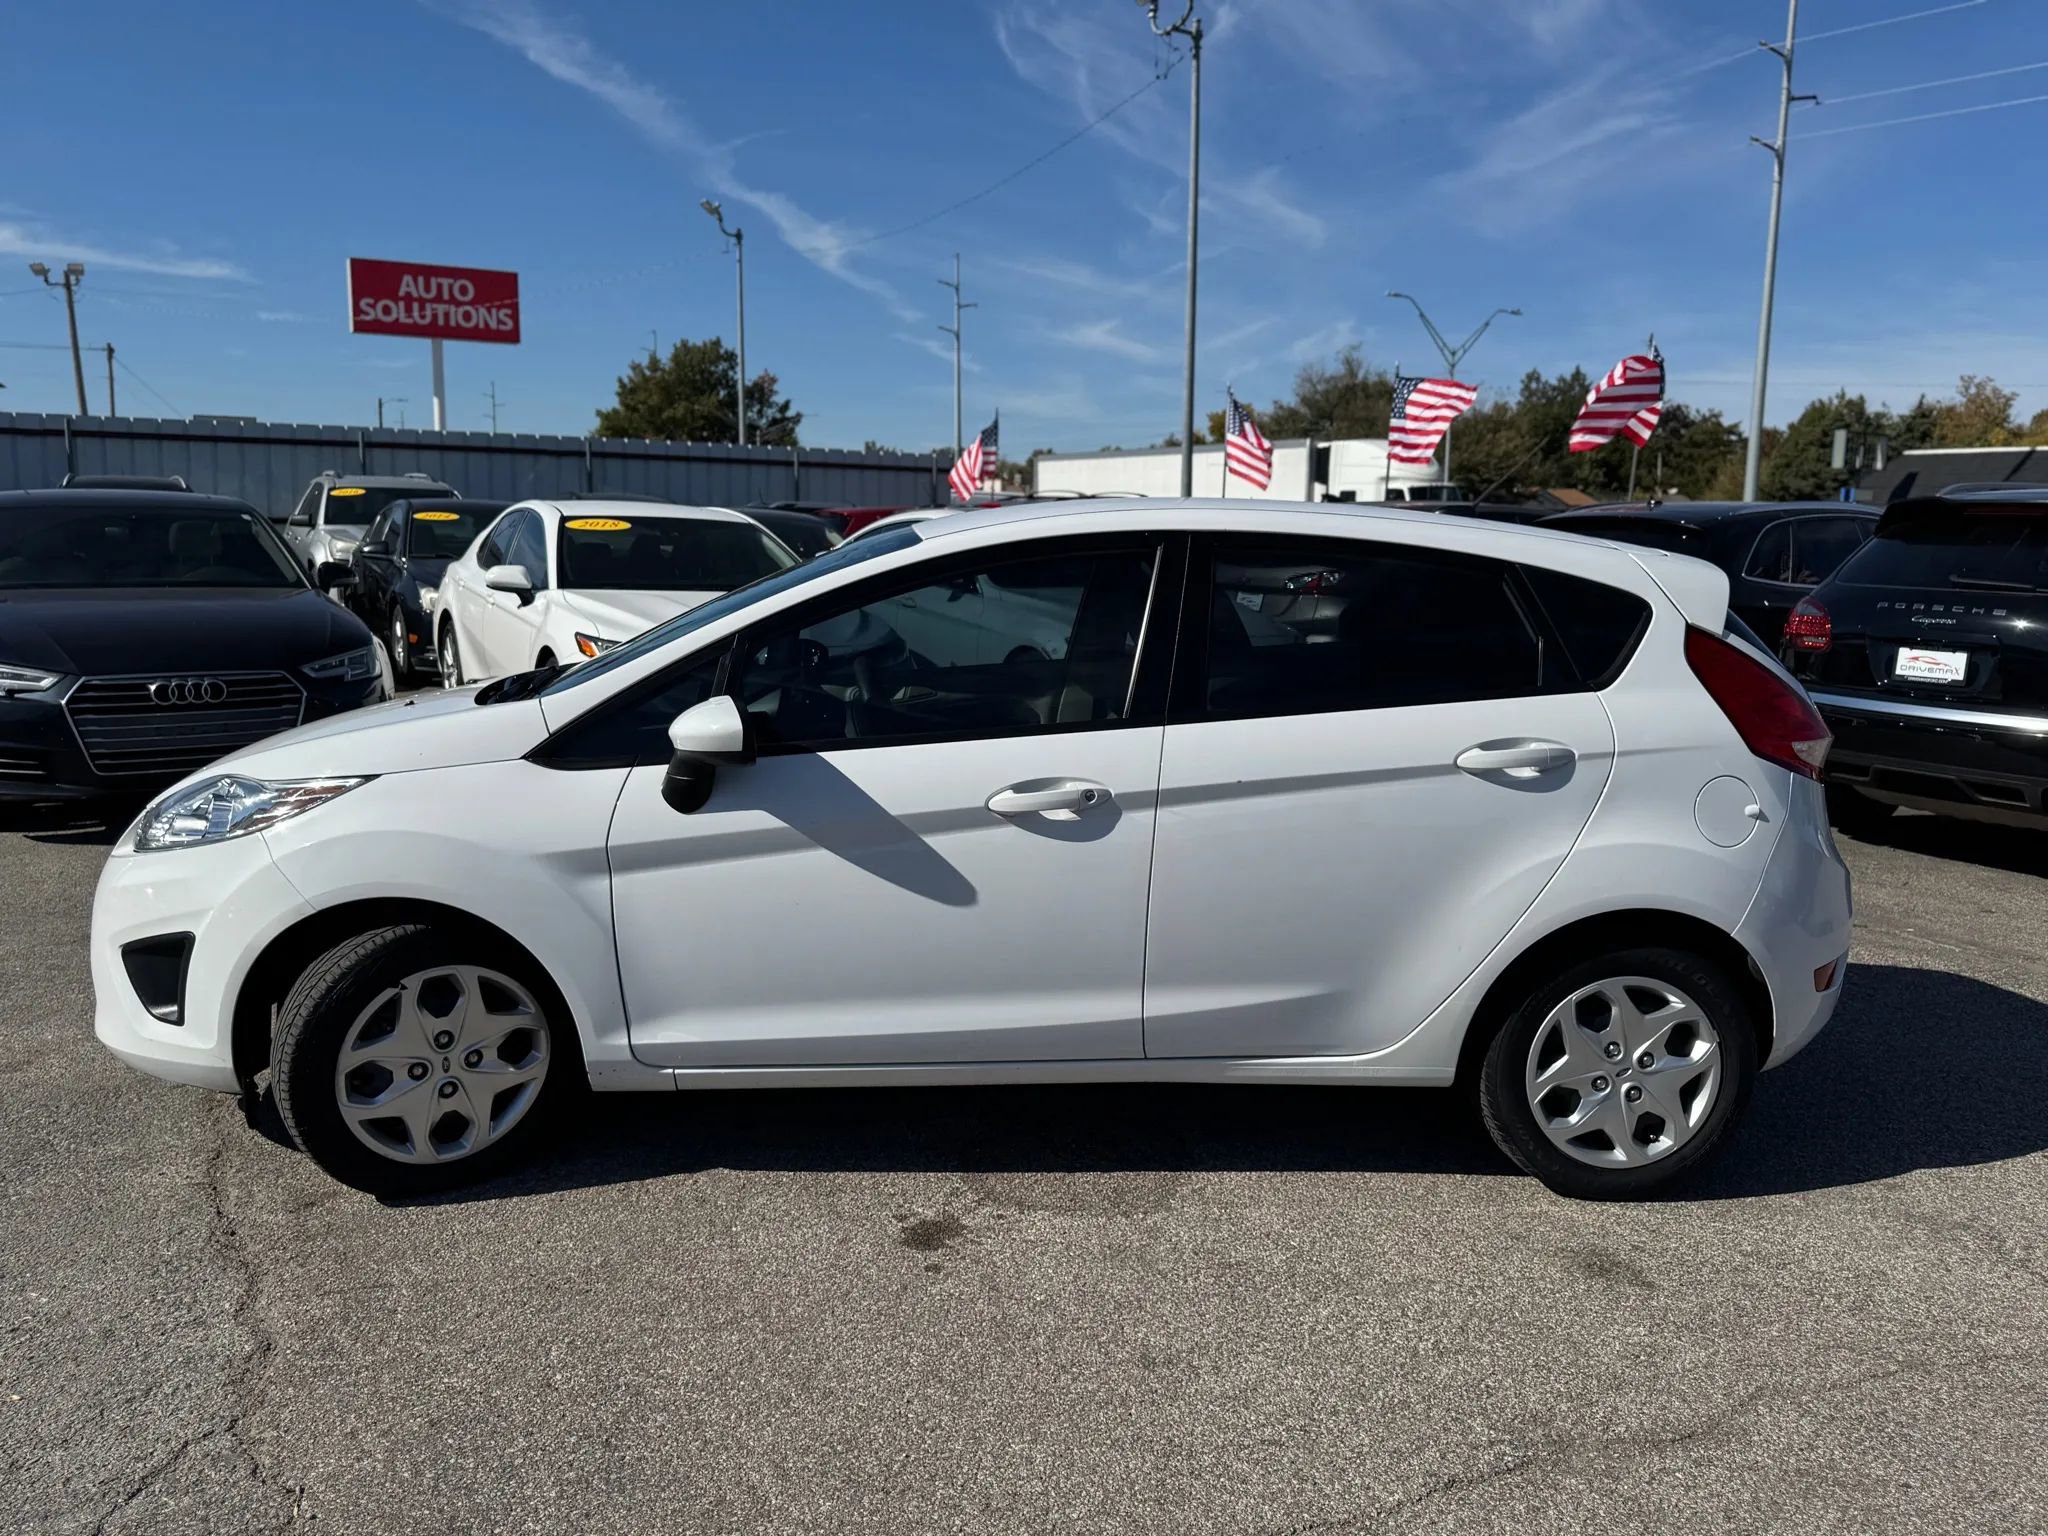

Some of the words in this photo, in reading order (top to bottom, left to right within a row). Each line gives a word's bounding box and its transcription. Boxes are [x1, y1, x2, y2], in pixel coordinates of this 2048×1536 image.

[398, 274, 475, 302] AUTO
[359, 298, 514, 331] SOLUTIONS
[577, 520, 620, 529] 2018
[1877, 601, 2007, 616] PORSCHE
[1900, 664, 1960, 676] DRIVEMAX
